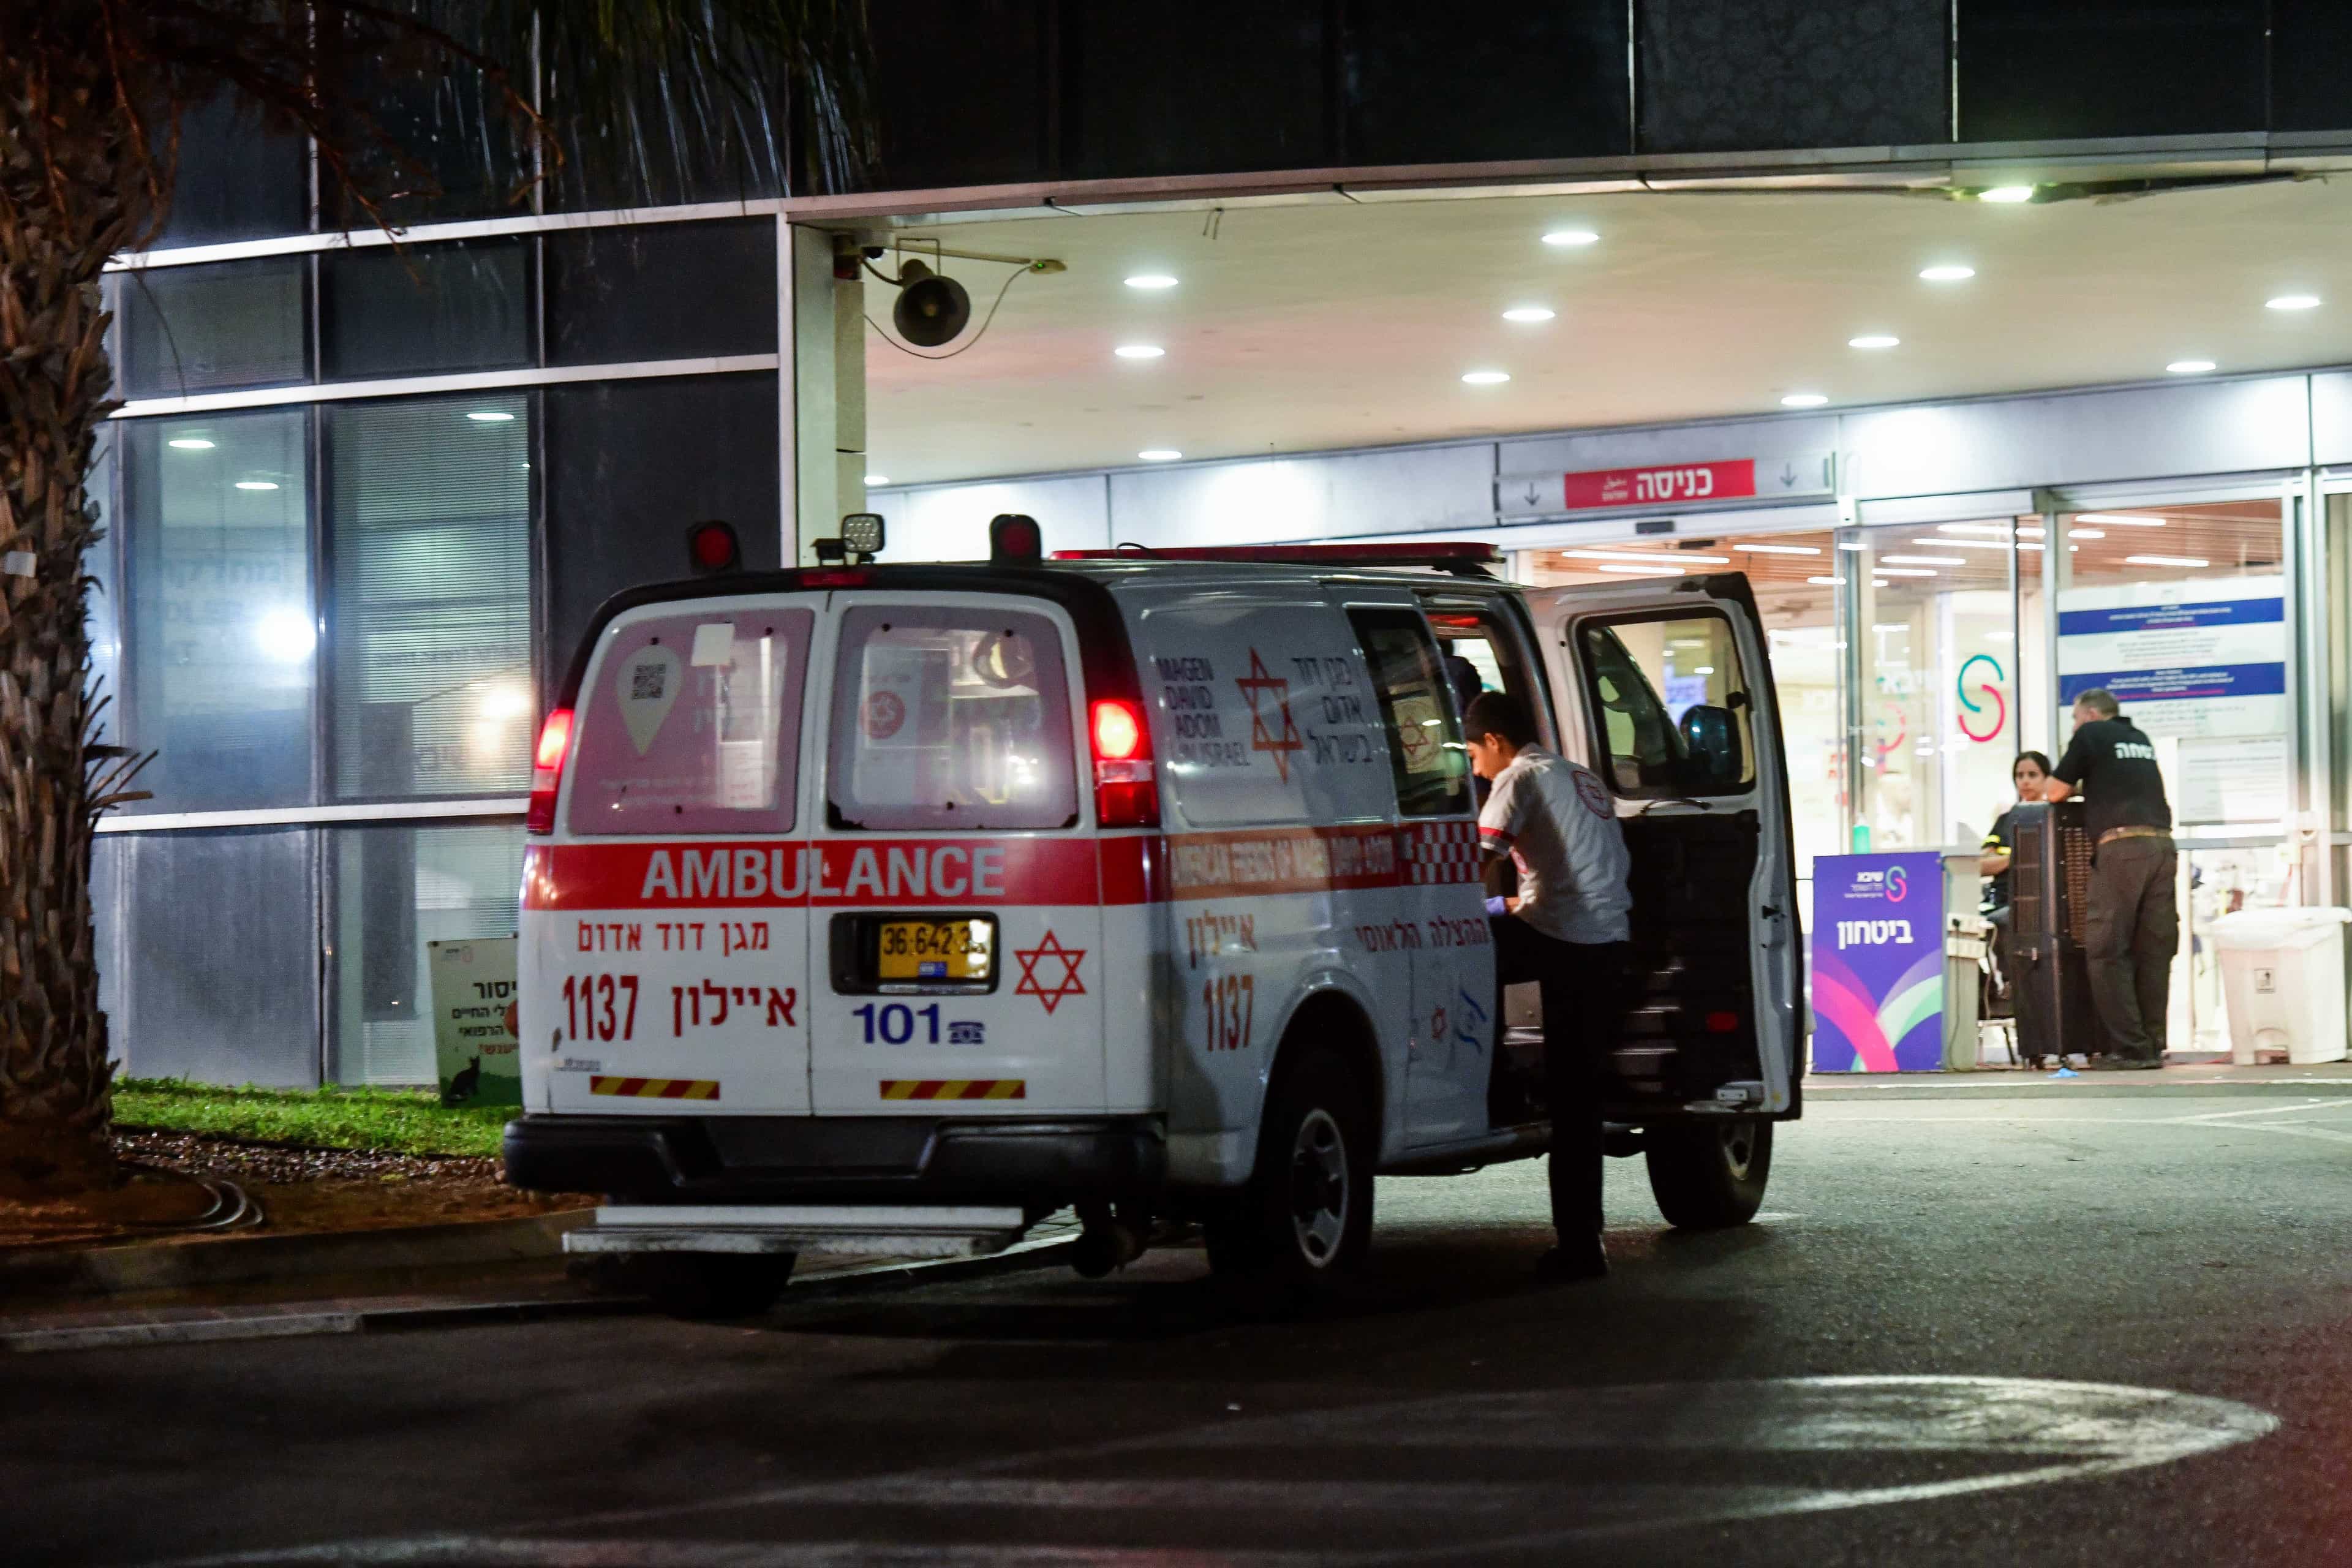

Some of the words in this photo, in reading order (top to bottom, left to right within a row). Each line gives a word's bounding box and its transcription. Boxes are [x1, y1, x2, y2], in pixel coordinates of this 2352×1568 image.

[1636, 467, 1713, 500] כניסה
[641, 846, 1006, 898] AMBULANCE
[578, 920, 641, 952] אדום
[656, 922, 705, 951] דוד
[720, 921, 769, 957] מגן
[1186, 909, 1259, 970] איילון
[1836, 919, 1914, 950] ביטחון
[473, 981, 517, 999] יסור
[563, 974, 639, 1041] 1137
[672, 979, 797, 1038] איילון
[852, 1003, 940, 1044] 101
[1203, 974, 1254, 1053] 1137
